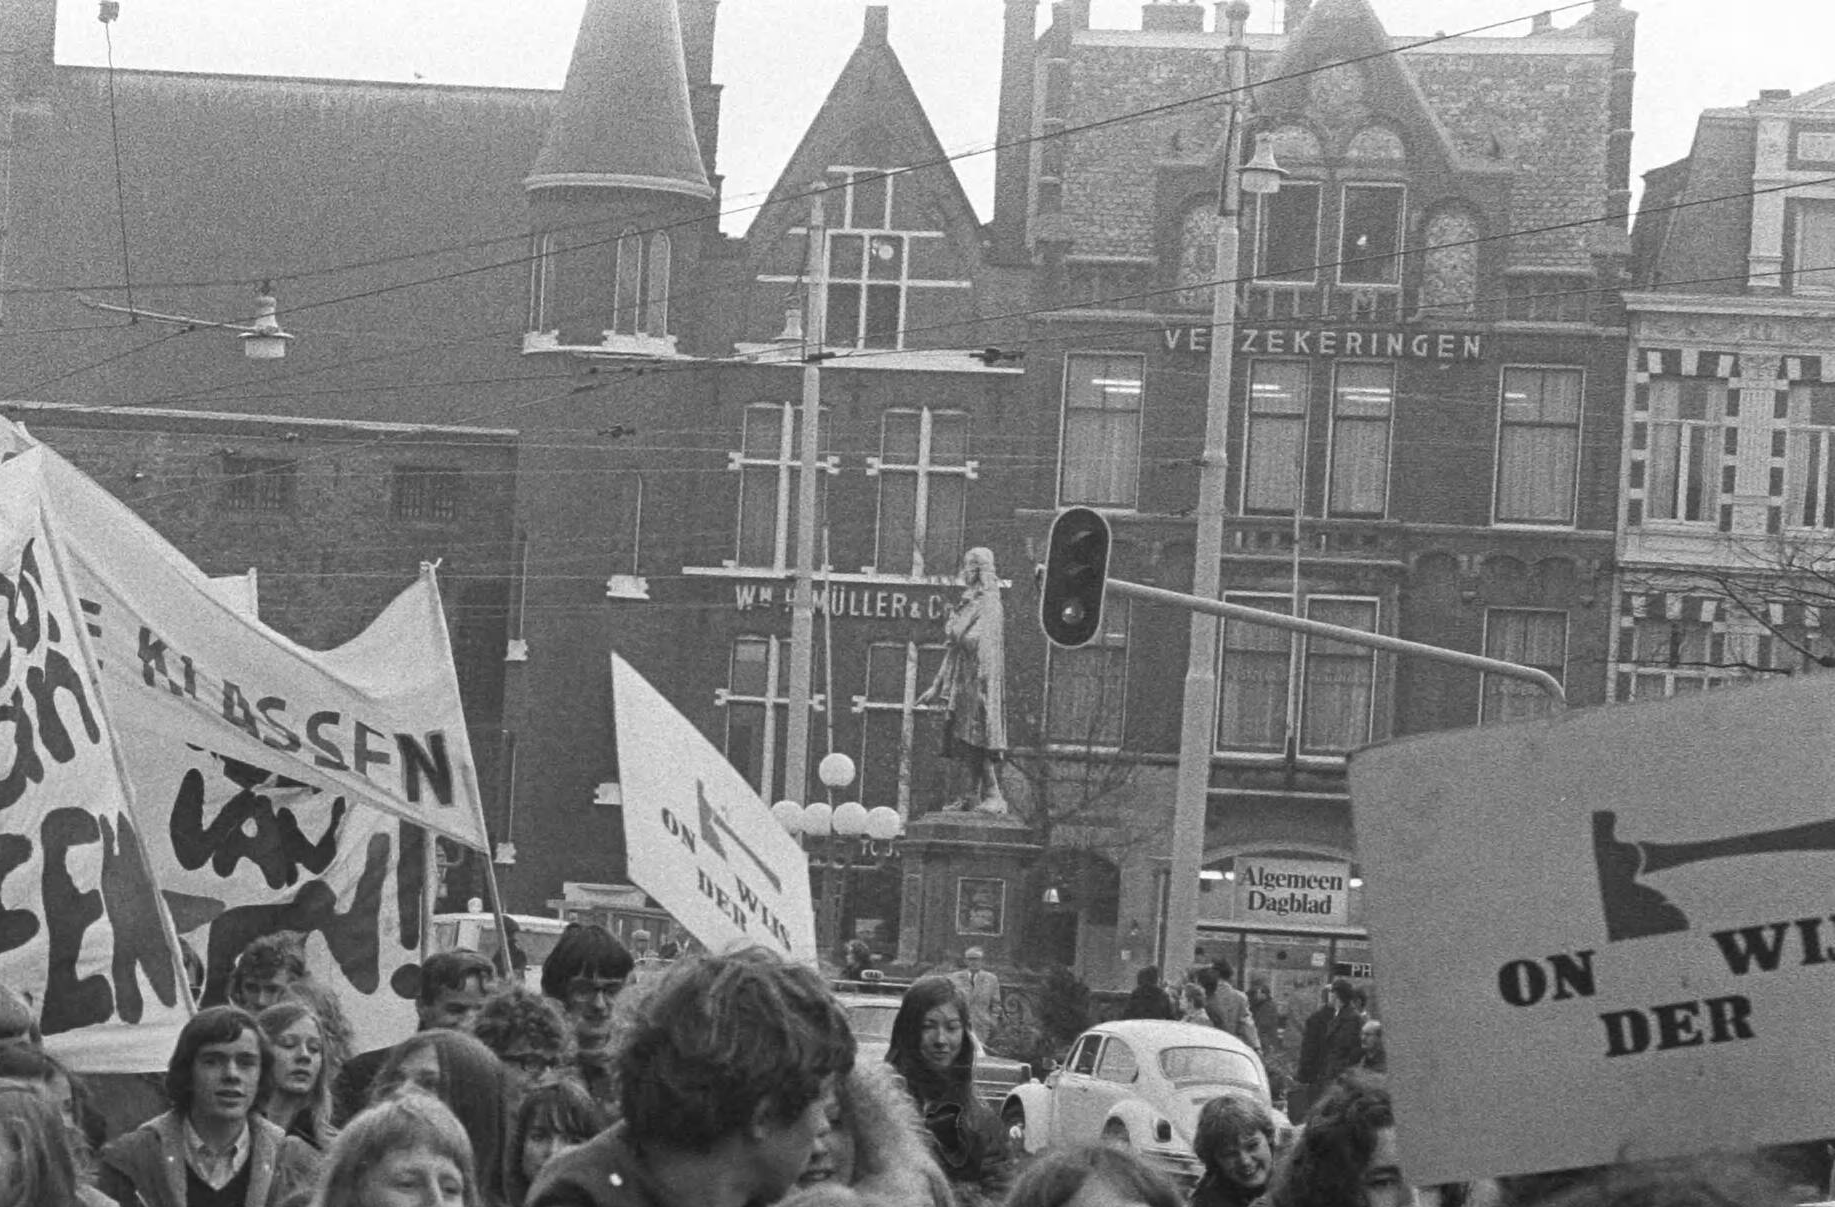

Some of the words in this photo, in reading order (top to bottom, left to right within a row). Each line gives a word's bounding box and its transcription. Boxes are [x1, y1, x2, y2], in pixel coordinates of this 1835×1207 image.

[1165, 328, 1482, 359] VEZEKERINGEN
[661, 806, 696, 854] ON
[697, 866, 748, 933] DER
[1237, 865, 1343, 891] Algemeen
[1247, 890, 1333, 916] Dagblad
[1498, 949, 1596, 1007] ON
[1710, 914, 1835, 976] WI
[1599, 994, 1756, 1059] DER
